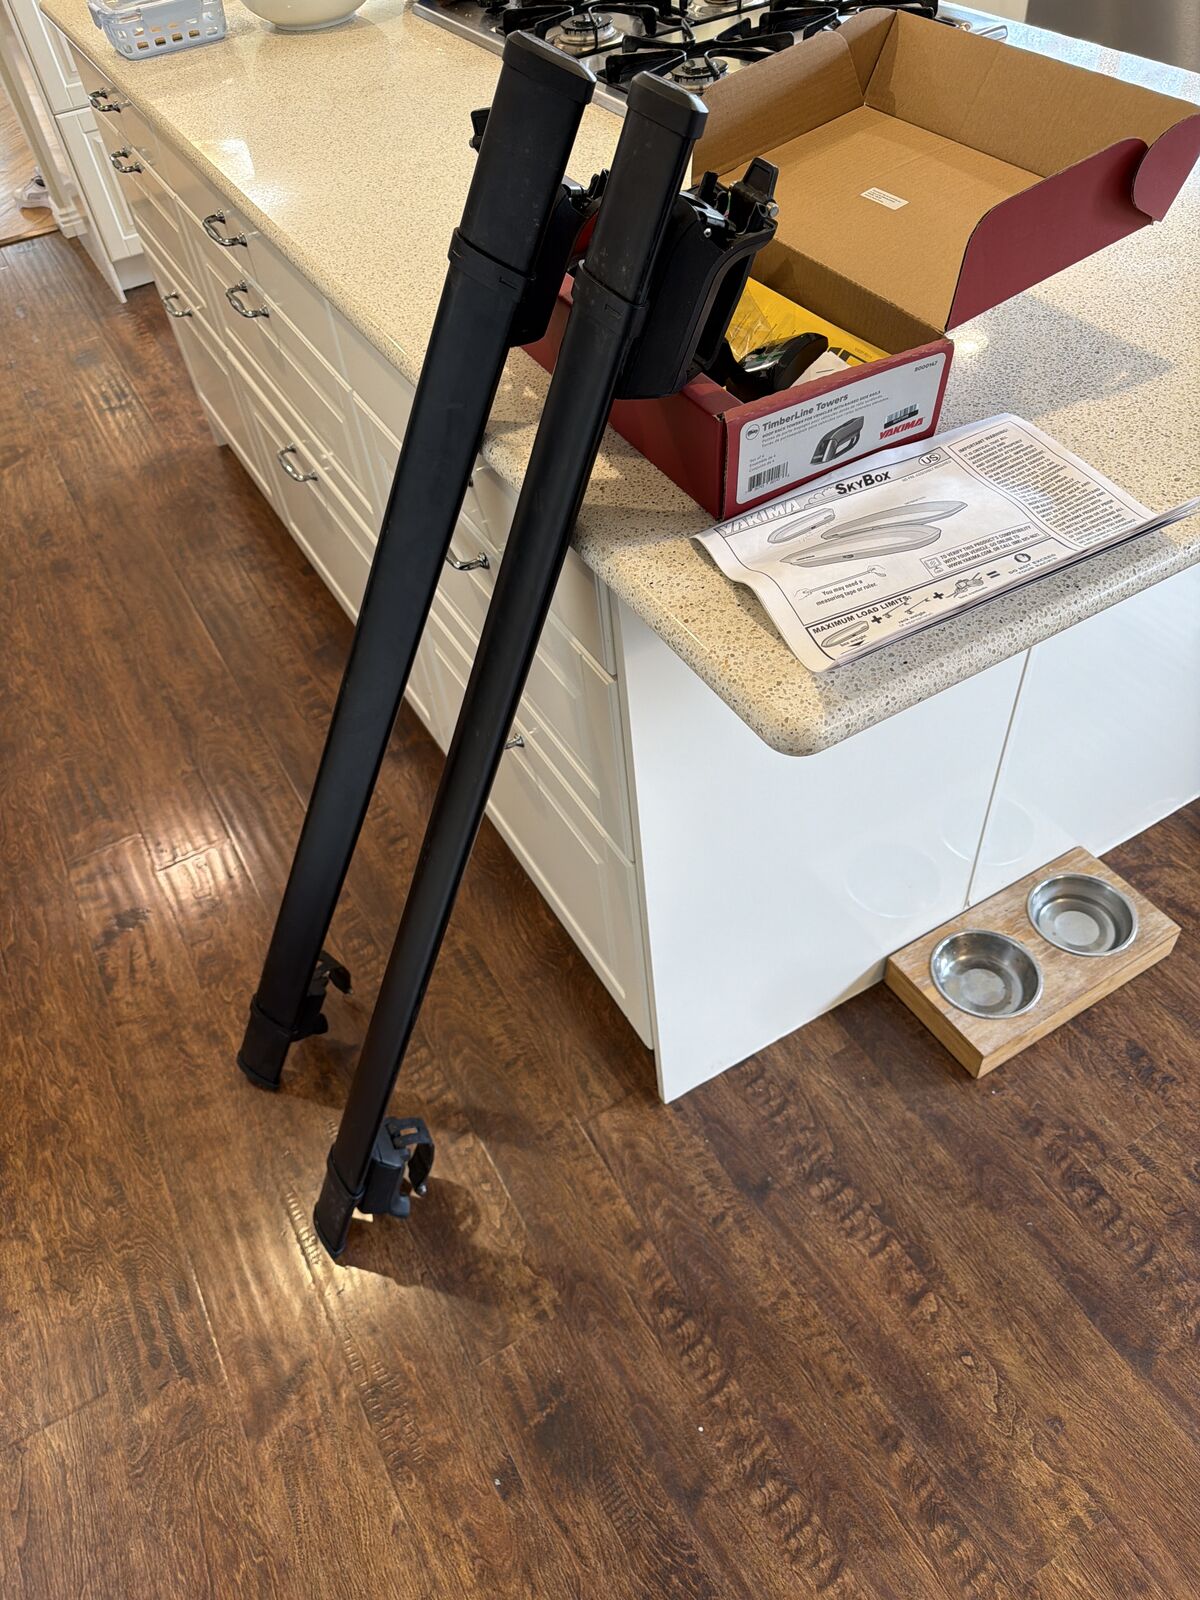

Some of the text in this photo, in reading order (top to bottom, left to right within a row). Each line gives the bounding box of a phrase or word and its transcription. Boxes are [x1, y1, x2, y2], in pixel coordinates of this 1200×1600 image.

[762, 407, 813, 431] TimberLine
[816, 394, 848, 411] Towers
[880, 418, 924, 439] YAKIMA
[719, 500, 801, 535] YAKIMA
[921, 454, 938, 464] US
[946, 548, 962, 557] VERIFY
[816, 593, 845, 606] measuring
[812, 596, 912, 633] MAXIMUM LOAD LIMITS:
